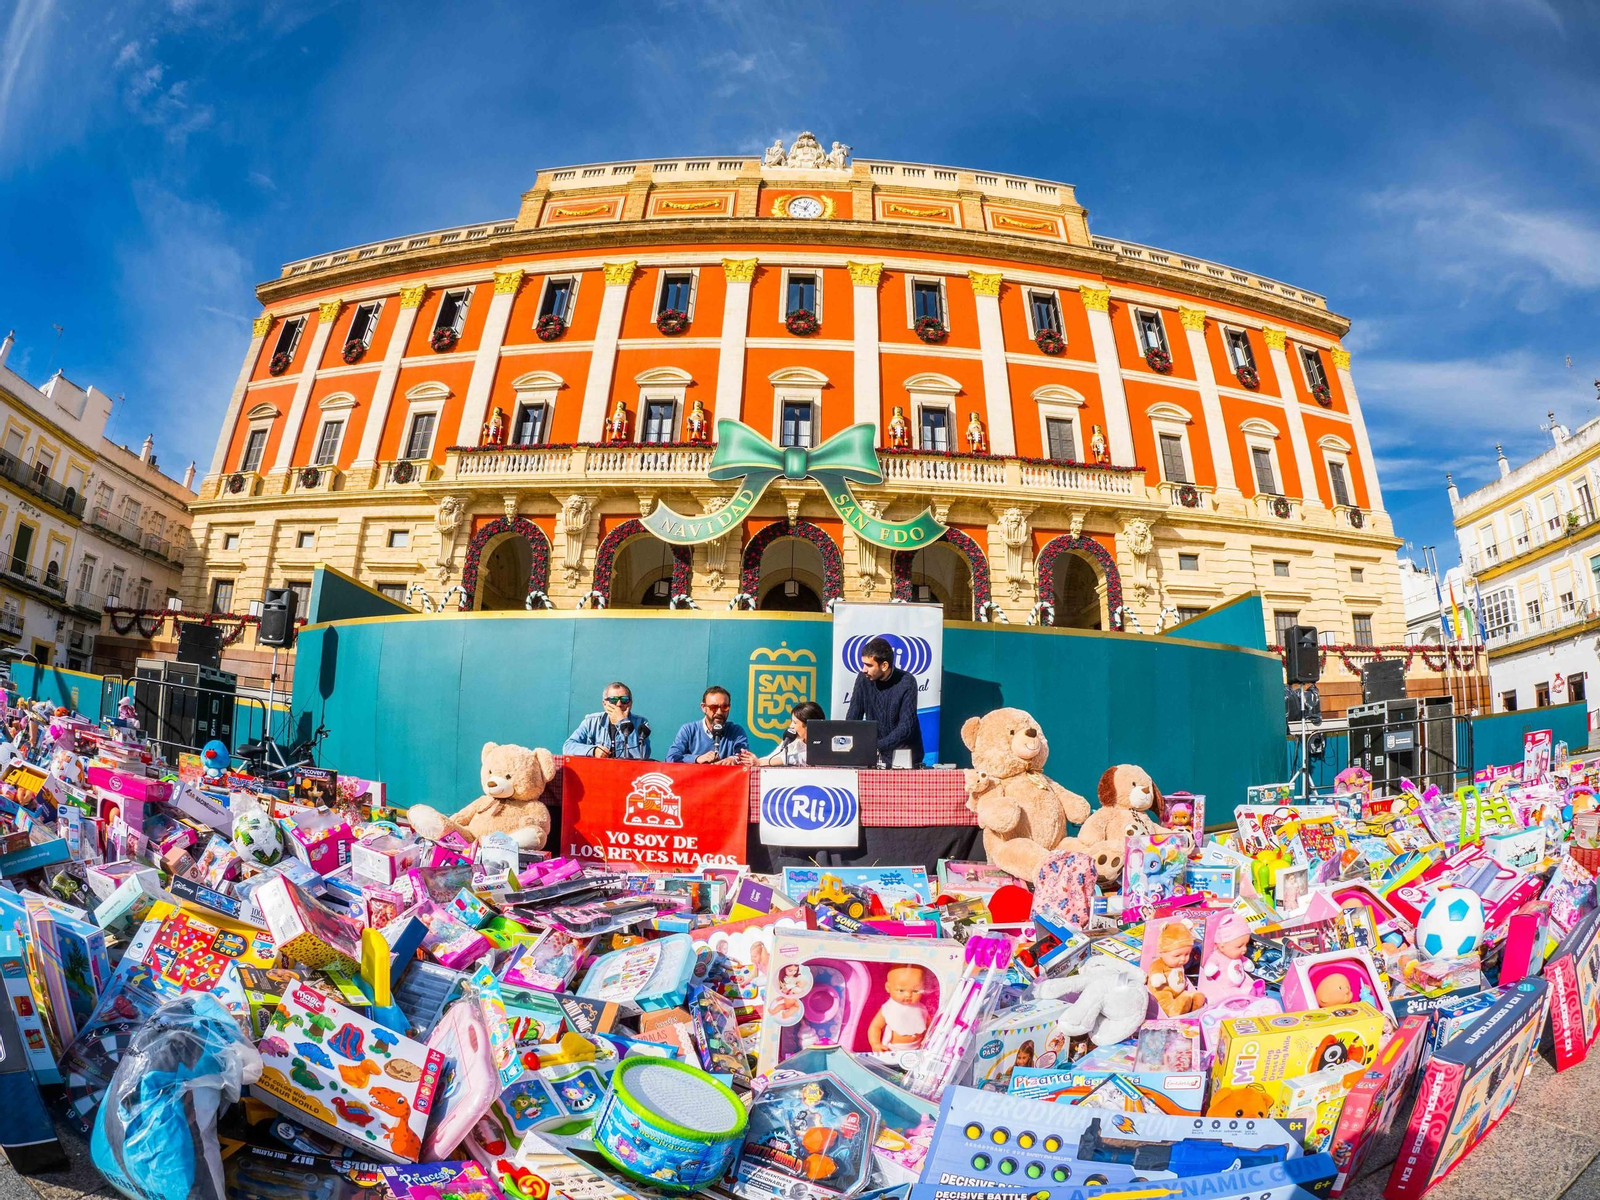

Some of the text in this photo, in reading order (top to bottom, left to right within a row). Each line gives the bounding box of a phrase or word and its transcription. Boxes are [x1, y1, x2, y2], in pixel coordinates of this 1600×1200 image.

[660, 489, 754, 537] NAVIDAD
[834, 494, 925, 543] SAN FDO
[758, 673, 807, 693] SAN
[791, 795, 825, 823] Rli
[605, 830, 698, 850] YO SOY DE
[569, 843, 738, 866] LOS REYES MAGOS
[173, 880, 195, 895] Disney
[250, 907, 265, 917] 100
[834, 913, 862, 931] SONIC
[294, 988, 323, 1009] magic
[102, 1027, 110, 1035] 9
[1465, 1006, 1507, 1045] SUPERJUEGOS
[981, 1044, 1002, 1058] PARK
[1276, 1035, 1292, 1081] Talking Milo
[1231, 1041, 1260, 1086] Milo
[1261, 1049, 1275, 1082] Amazing
[1269, 1048, 1283, 1082] Dress Up
[273, 1076, 294, 1092] COLOR
[293, 1089, 307, 1100] MUD
[1013, 1071, 1073, 1090] Pizarra
[258, 1078, 320, 1115] NOSAUR WORLD
[66, 1108, 76, 1119] 19
[1411, 1071, 1445, 1154] SUPERJUEGOS
[80, 1124, 89, 1133] 3
[1289, 1122, 1304, 1131] 6+
[356, 1172, 378, 1182] MY
[1268, 1158, 1321, 1184] GUN
[1401, 1167, 1414, 1182] EN
[935, 1190, 1028, 1200] DECISIVE BATTLE
[1313, 1180, 1332, 1191] 6+
